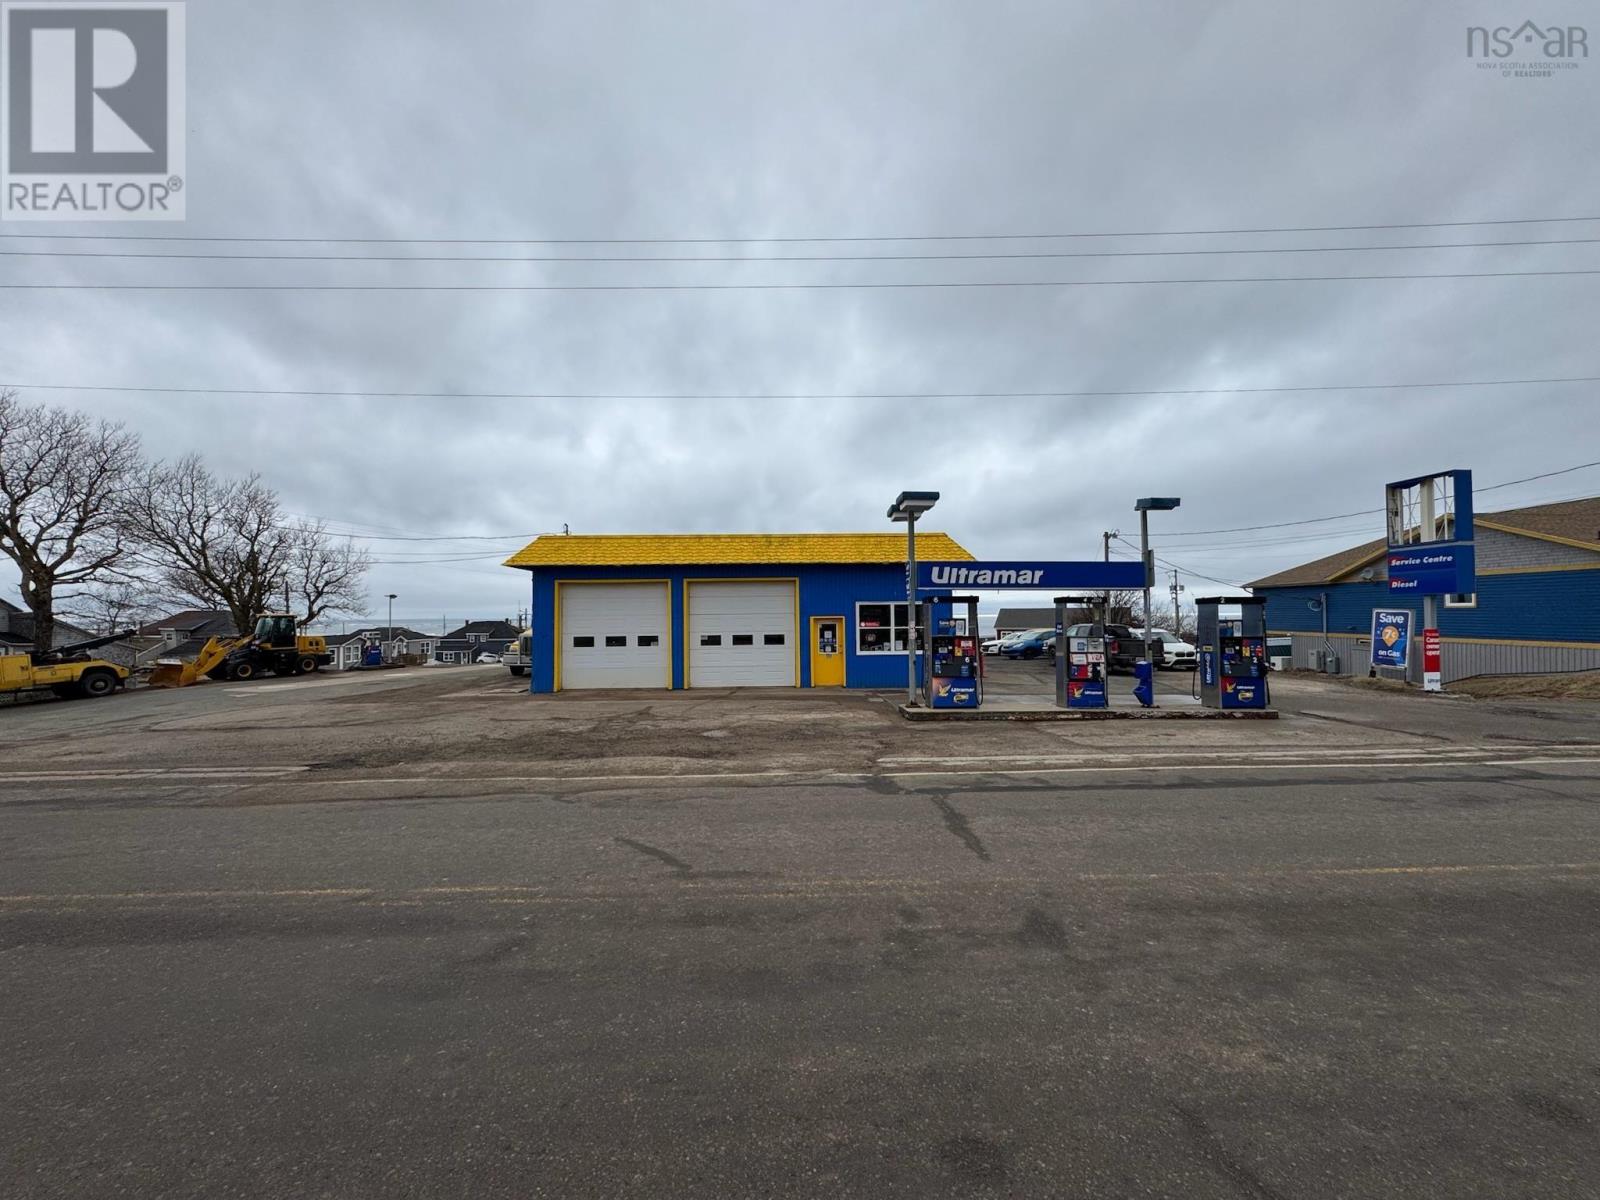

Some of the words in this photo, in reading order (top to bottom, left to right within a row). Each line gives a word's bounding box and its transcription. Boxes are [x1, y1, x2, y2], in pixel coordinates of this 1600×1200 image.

[1391, 558, 1420, 566] Service
[931, 566, 1044, 584] Ultramar
[1391, 580, 1417, 588] Diesel
[1379, 613, 1404, 623] Save
[1387, 649, 1400, 657] Gas
